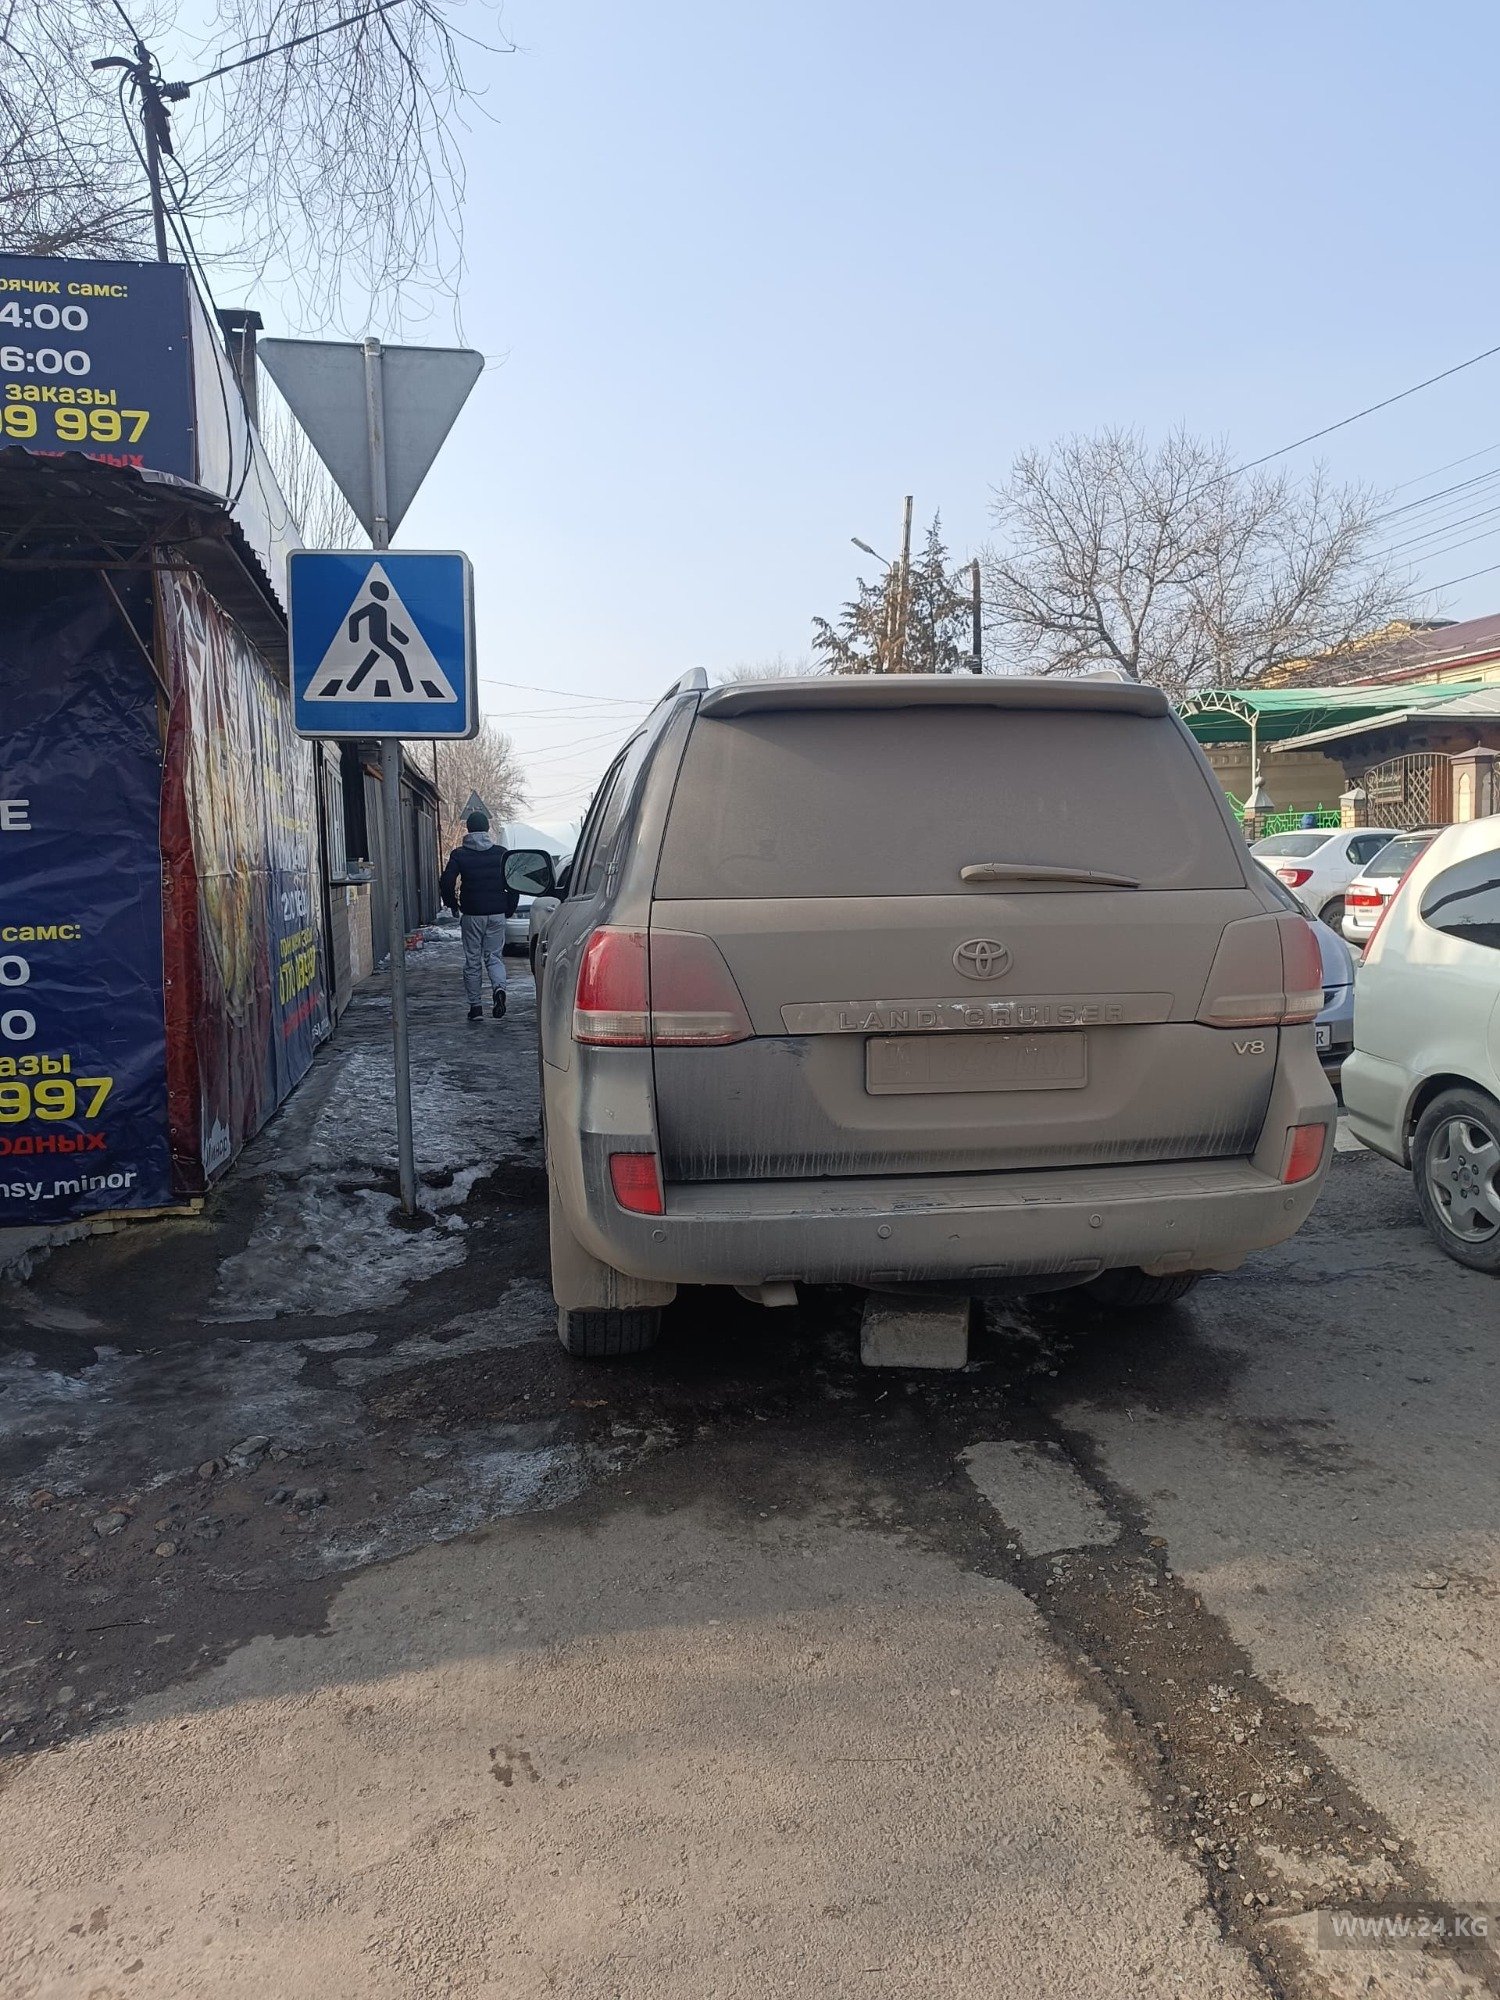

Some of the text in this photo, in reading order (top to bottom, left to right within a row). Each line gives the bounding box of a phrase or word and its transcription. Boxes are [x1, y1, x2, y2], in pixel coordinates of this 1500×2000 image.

[67, 281, 128, 298] самс:
[0, 301, 89, 331] 4:00
[0, 346, 91, 376] 6:00
[5, 383, 117, 406] заказы
[0, 404, 150, 443] 9 997
[1, 924, 82, 942] самс:
[838, 1003, 1125, 1031] LAND CRUISER
[1232, 1040, 1266, 1055] V8
[0, 1076, 114, 1123] 997
